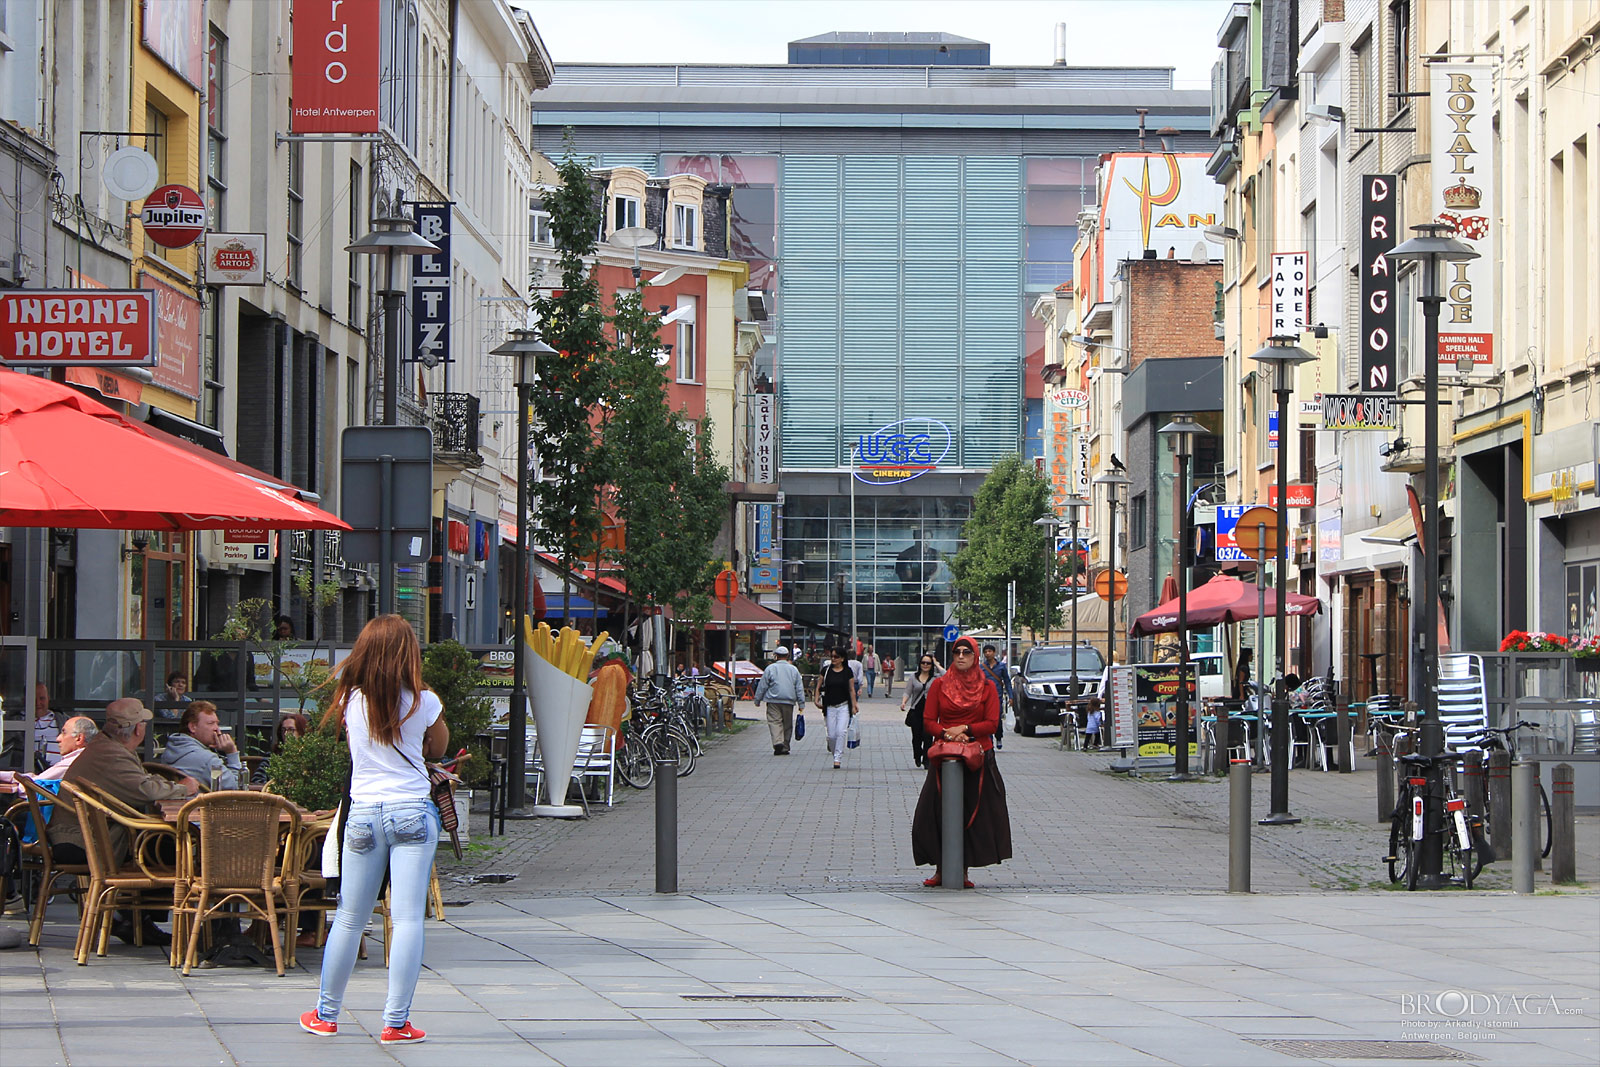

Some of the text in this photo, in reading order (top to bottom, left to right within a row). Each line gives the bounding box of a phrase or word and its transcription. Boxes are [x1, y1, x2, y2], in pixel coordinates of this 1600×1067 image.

[295, 108, 376, 118] Hotel Antwerpen
[1446, 73, 1478, 174] ROYAL
[145, 209, 203, 227] Jupiler
[220, 252, 250, 260] STELLA
[220, 260, 251, 268] ARTOIS
[1370, 178, 1389, 389] DRAGON
[1448, 243, 1473, 324] ICE
[1275, 256, 1285, 337] TAVER
[8, 299, 139, 325] INGANG
[15, 331, 133, 357] HOTEL
[1439, 336, 1485, 344] GAMING HALL
[1445, 345, 1479, 353] SPEELHAL
[1472, 354, 1489, 362] JEUX
[1053, 390, 1088, 402] MEXICO
[1060, 397, 1081, 406] CITY
[757, 395, 771, 484] Satay Hous
[859, 434, 932, 464] UGC
[872, 470, 912, 478] CINEMAS
[1272, 495, 1311, 505] Rmbouts
[1221, 506, 1240, 519] TE
[224, 547, 267, 560] Parking P
